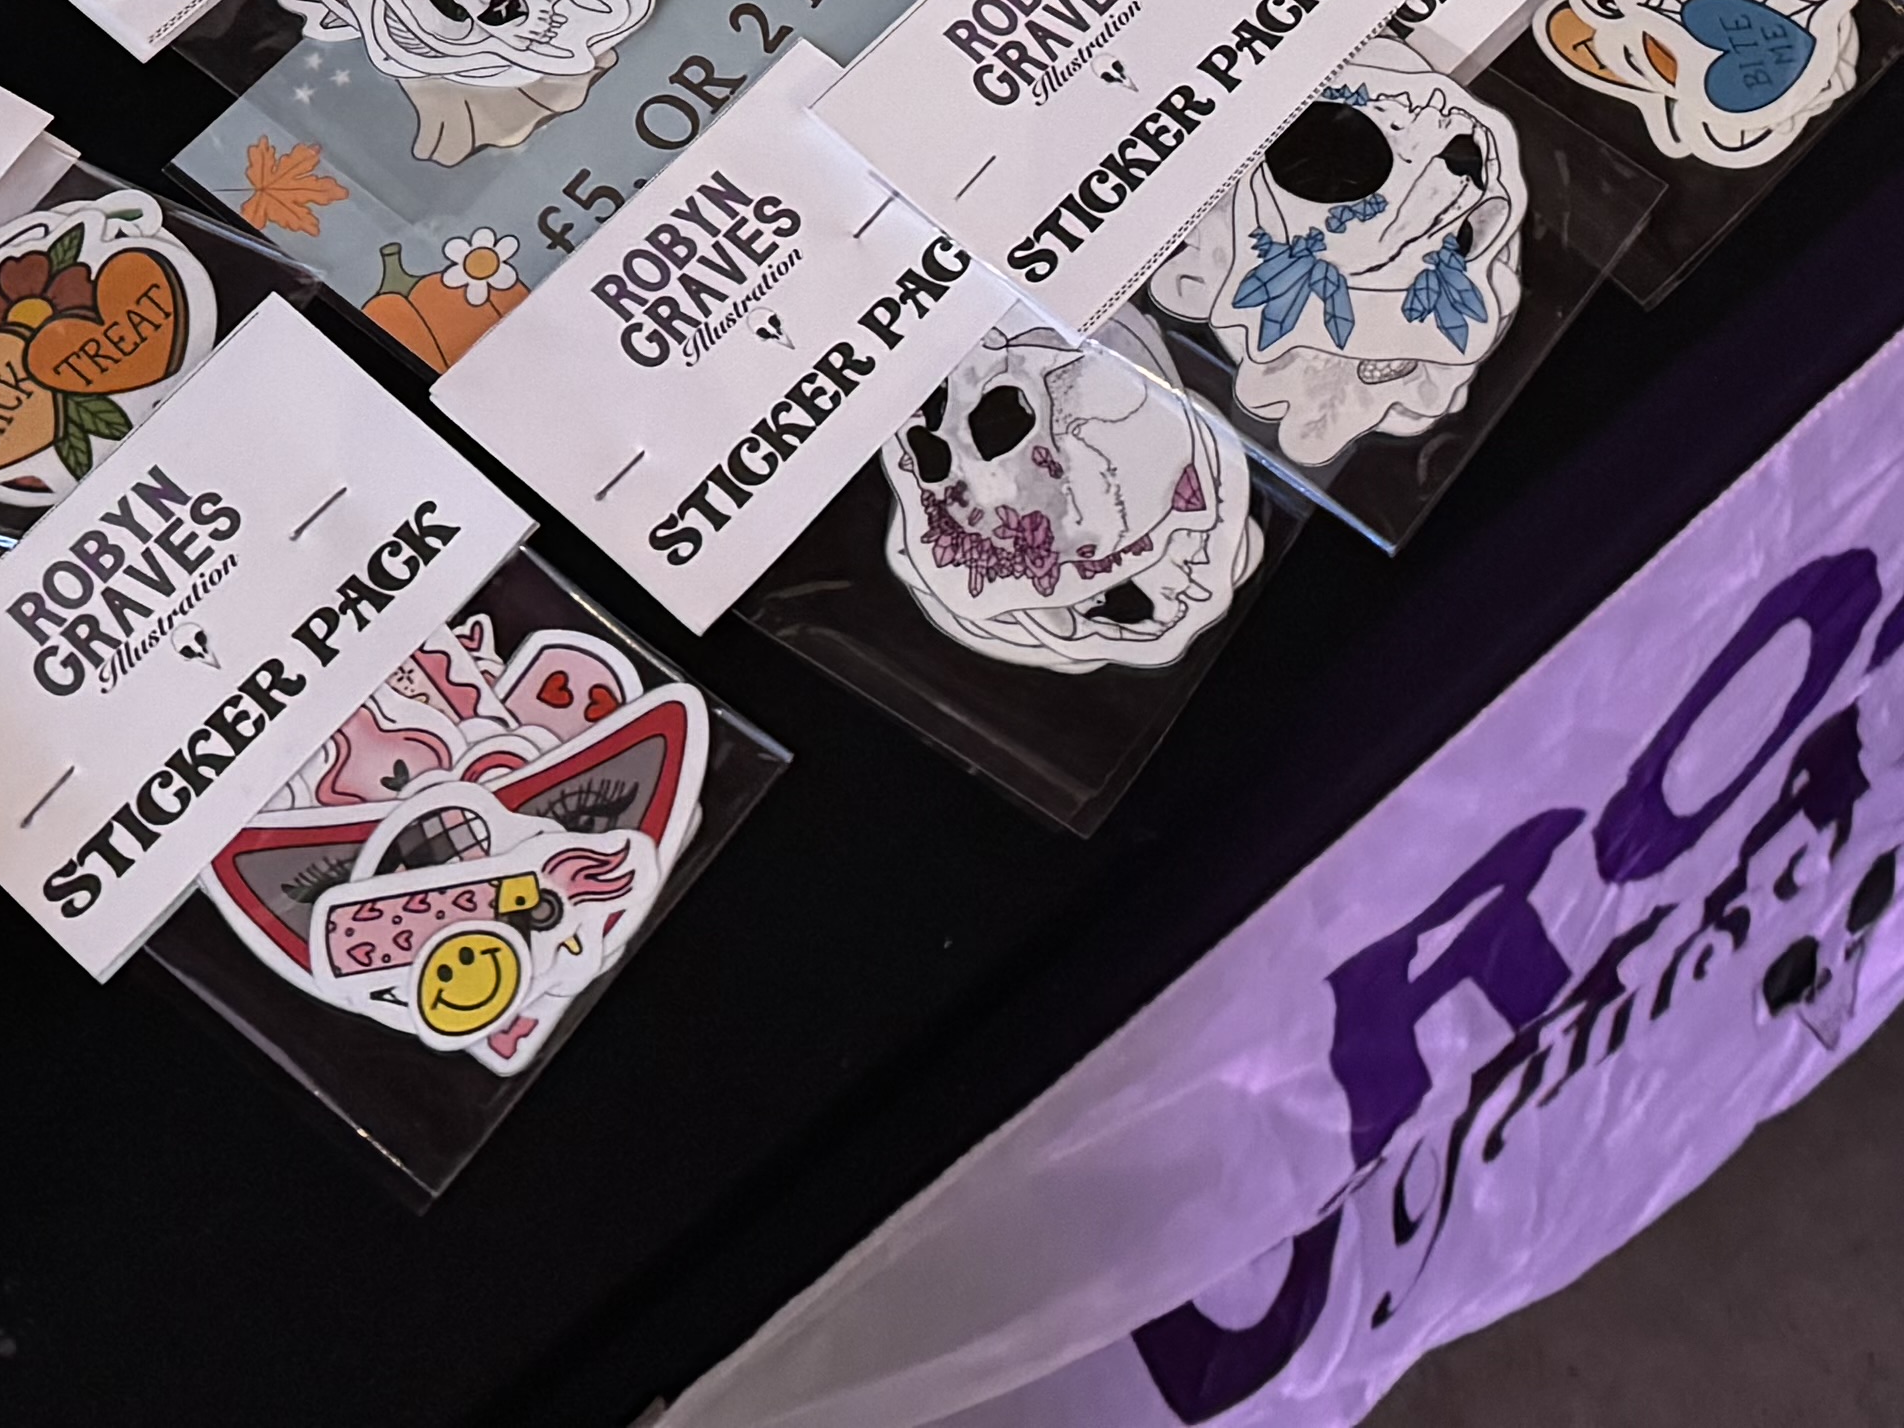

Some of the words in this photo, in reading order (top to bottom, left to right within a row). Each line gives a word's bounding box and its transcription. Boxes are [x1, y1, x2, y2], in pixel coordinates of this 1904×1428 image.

[635, 55, 748, 152] OR
[730, 3, 795, 52] 2
[1031, 0, 1142, 106] Illustration
[1720, 13, 1773, 90] BITE
[1760, 23, 1796, 66] ME
[590, 171, 754, 319] ROBYN
[1005, 82, 1216, 285] STICKER
[54, 294, 175, 388] TREAT
[619, 195, 804, 367] GRAVES
[682, 244, 805, 367] Illustration
[648, 338, 877, 566] STICKER
[858, 233, 970, 350] PAC
[5, 464, 191, 647] ROBYN
[30, 492, 243, 699] GRAVES
[97, 552, 240, 694] Illustration
[42, 657, 308, 919] STICKER
[292, 501, 462, 665] PACK
